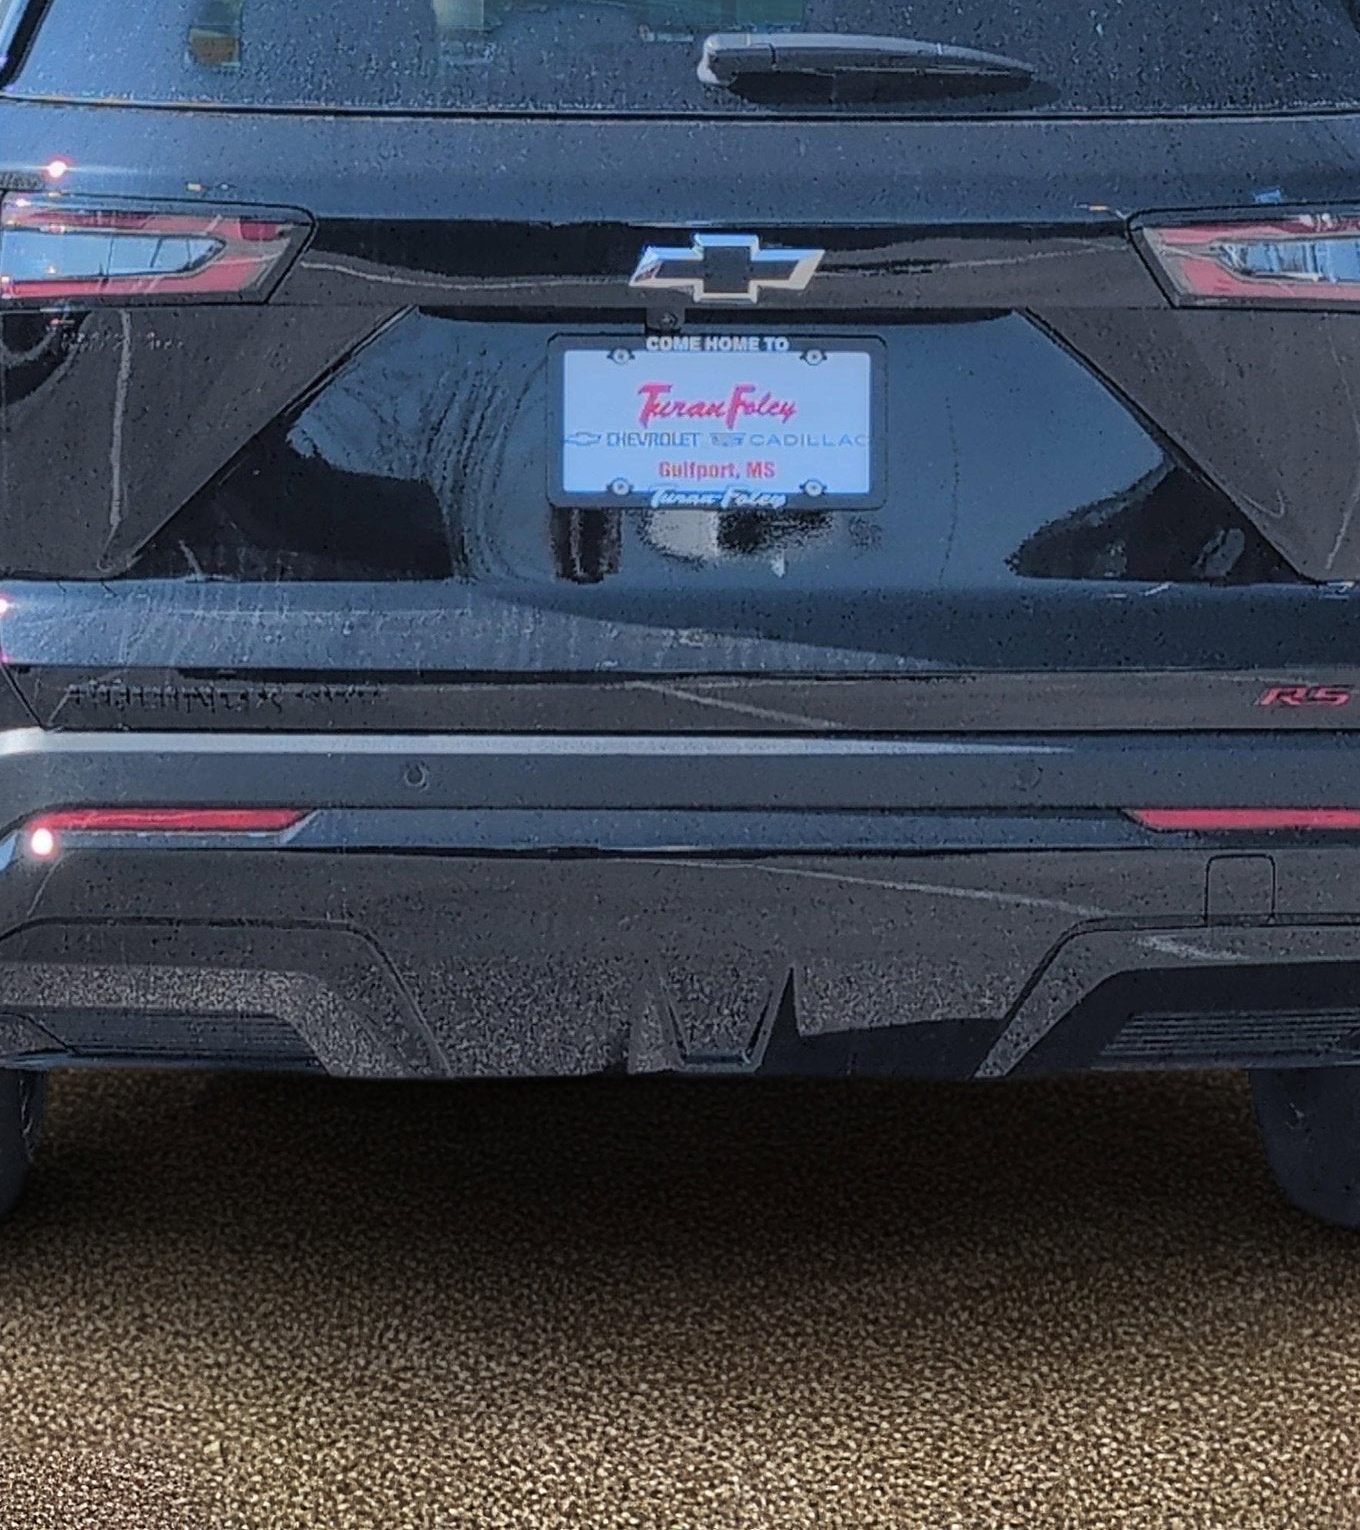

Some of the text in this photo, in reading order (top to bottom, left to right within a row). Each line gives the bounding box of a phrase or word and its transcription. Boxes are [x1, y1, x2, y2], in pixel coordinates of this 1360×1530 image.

[646, 336, 789, 351] COME HOME TO
[637, 381, 796, 430] Turan Foley
[607, 432, 697, 447] CHEVROLET
[658, 461, 776, 480] Gulfport, MS
[1257, 686, 1352, 706] RS
